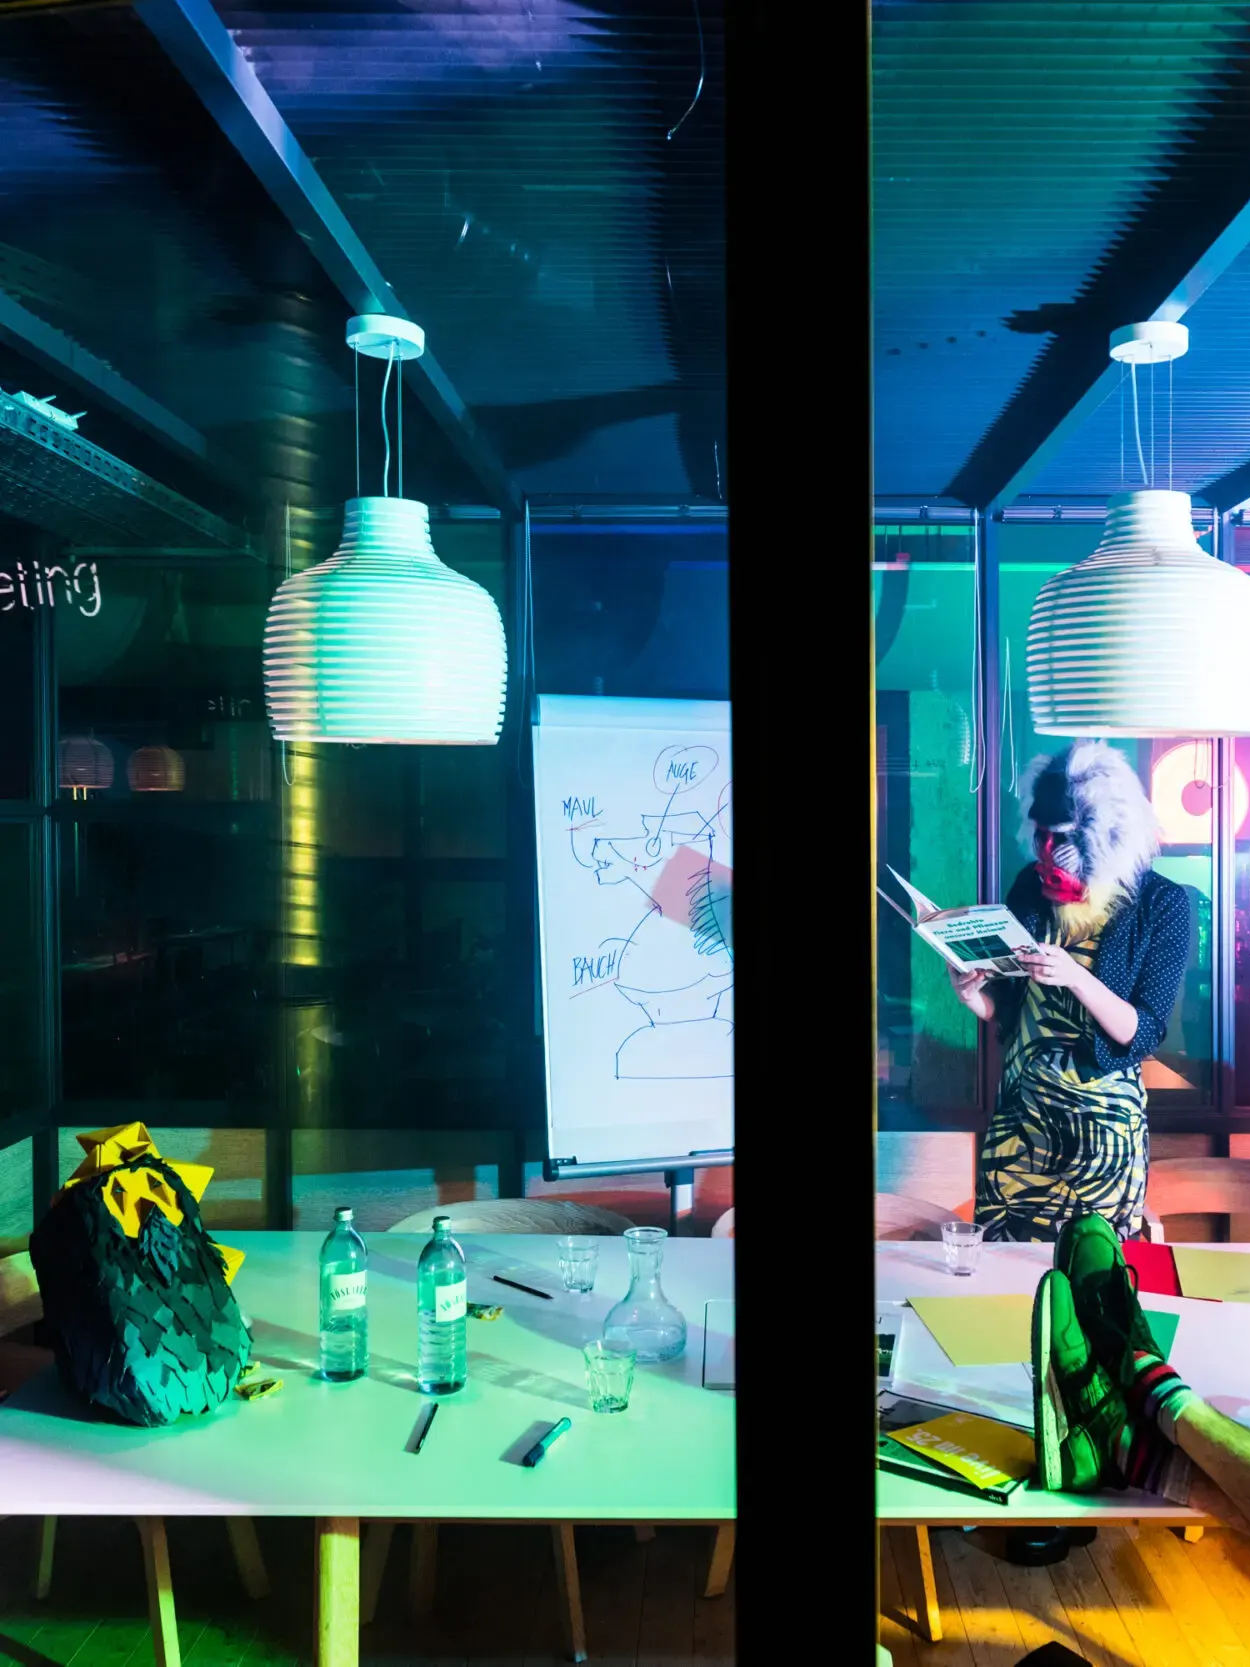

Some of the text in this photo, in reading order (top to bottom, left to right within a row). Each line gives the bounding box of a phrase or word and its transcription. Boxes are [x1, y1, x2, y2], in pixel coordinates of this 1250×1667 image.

[666, 760, 699, 784] AUGE
[562, 797, 604, 819] MAUL
[572, 950, 617, 986] BAUCH
